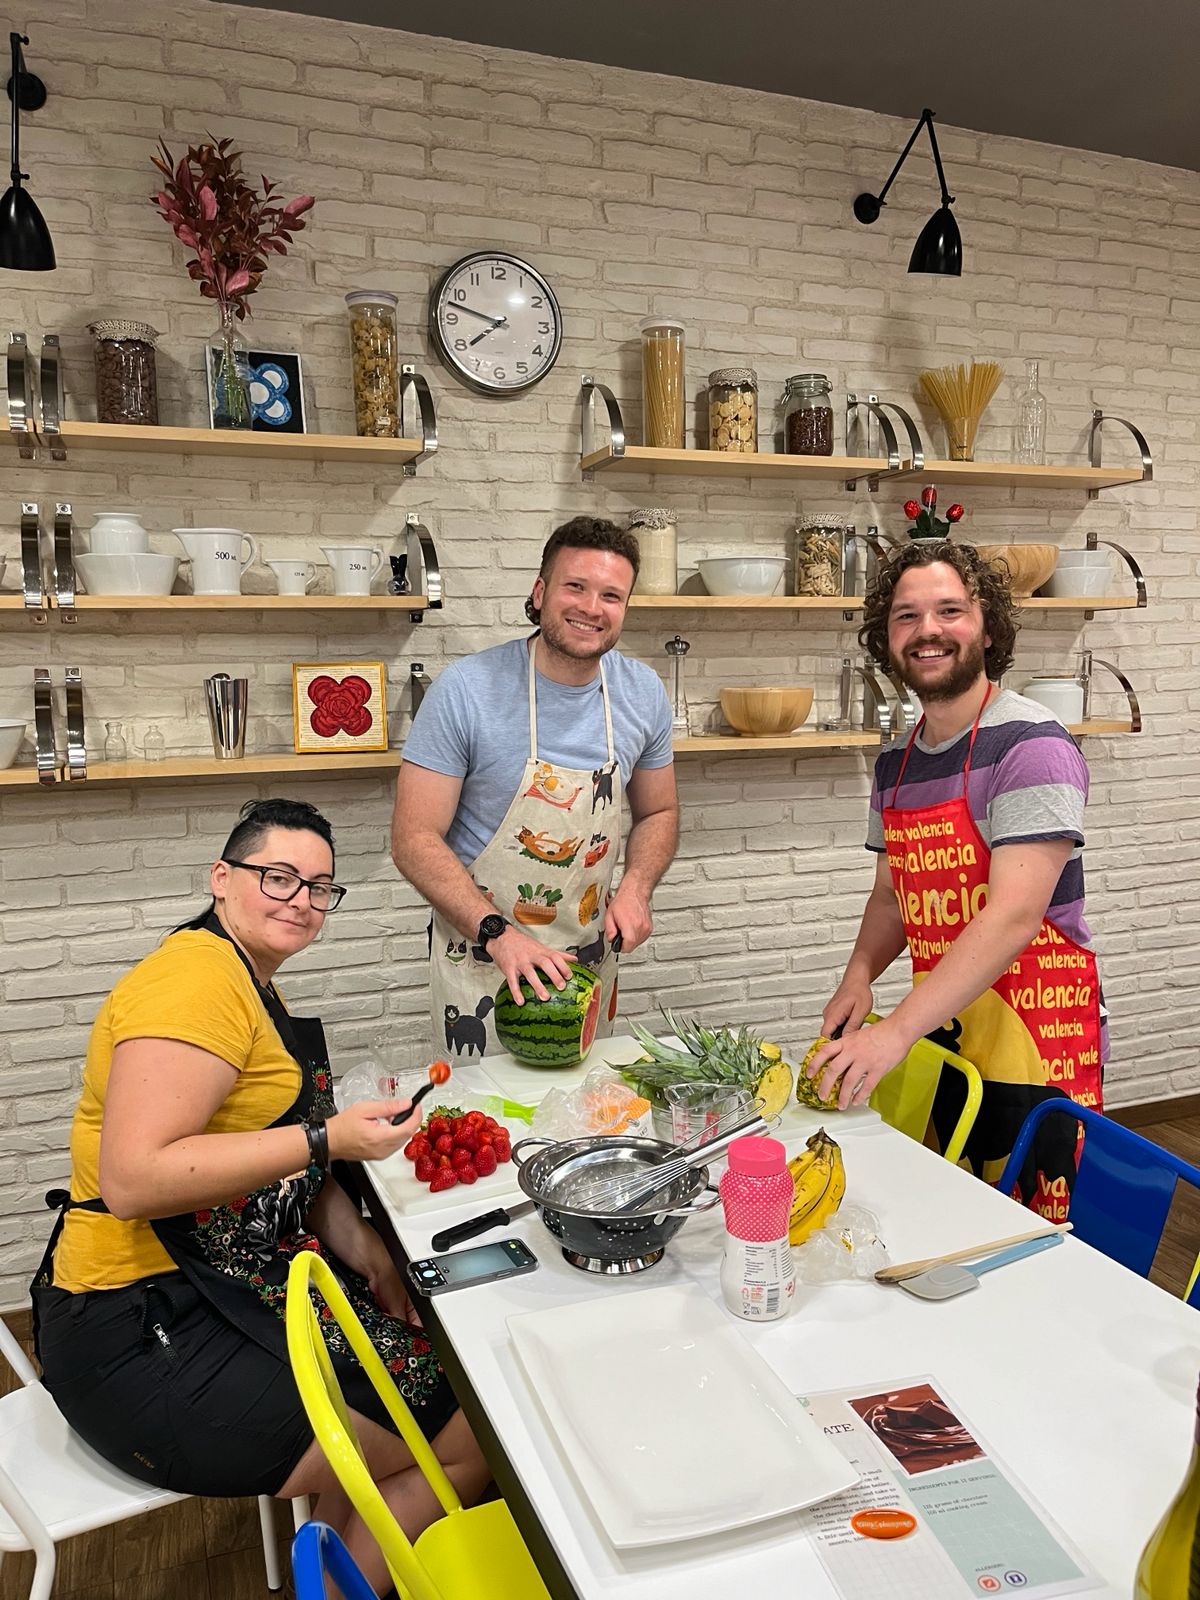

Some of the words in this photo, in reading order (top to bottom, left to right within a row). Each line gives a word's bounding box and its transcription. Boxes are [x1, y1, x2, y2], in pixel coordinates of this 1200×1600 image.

[471, 272, 480, 286] 11
[491, 266, 507, 281] 12
[454, 288, 467, 302] 10
[531, 296, 543, 309] 2
[446, 312, 459, 325] 9
[538, 321, 550, 335] 3
[454, 339, 468, 352] 8
[532, 345, 544, 357] 4
[493, 367, 506, 380] 6
[516, 362, 529, 374] 5
[215, 551, 230, 561] 500
[349, 563, 361, 571] 250
[905, 818, 955, 841] valencia
[930, 936, 955, 956] vale
[1037, 949, 1087, 970] valencia
[1009, 977, 1091, 1010] valencia
[1039, 1018, 1084, 1039] valencia
[823, 1423, 855, 1435] ATE
